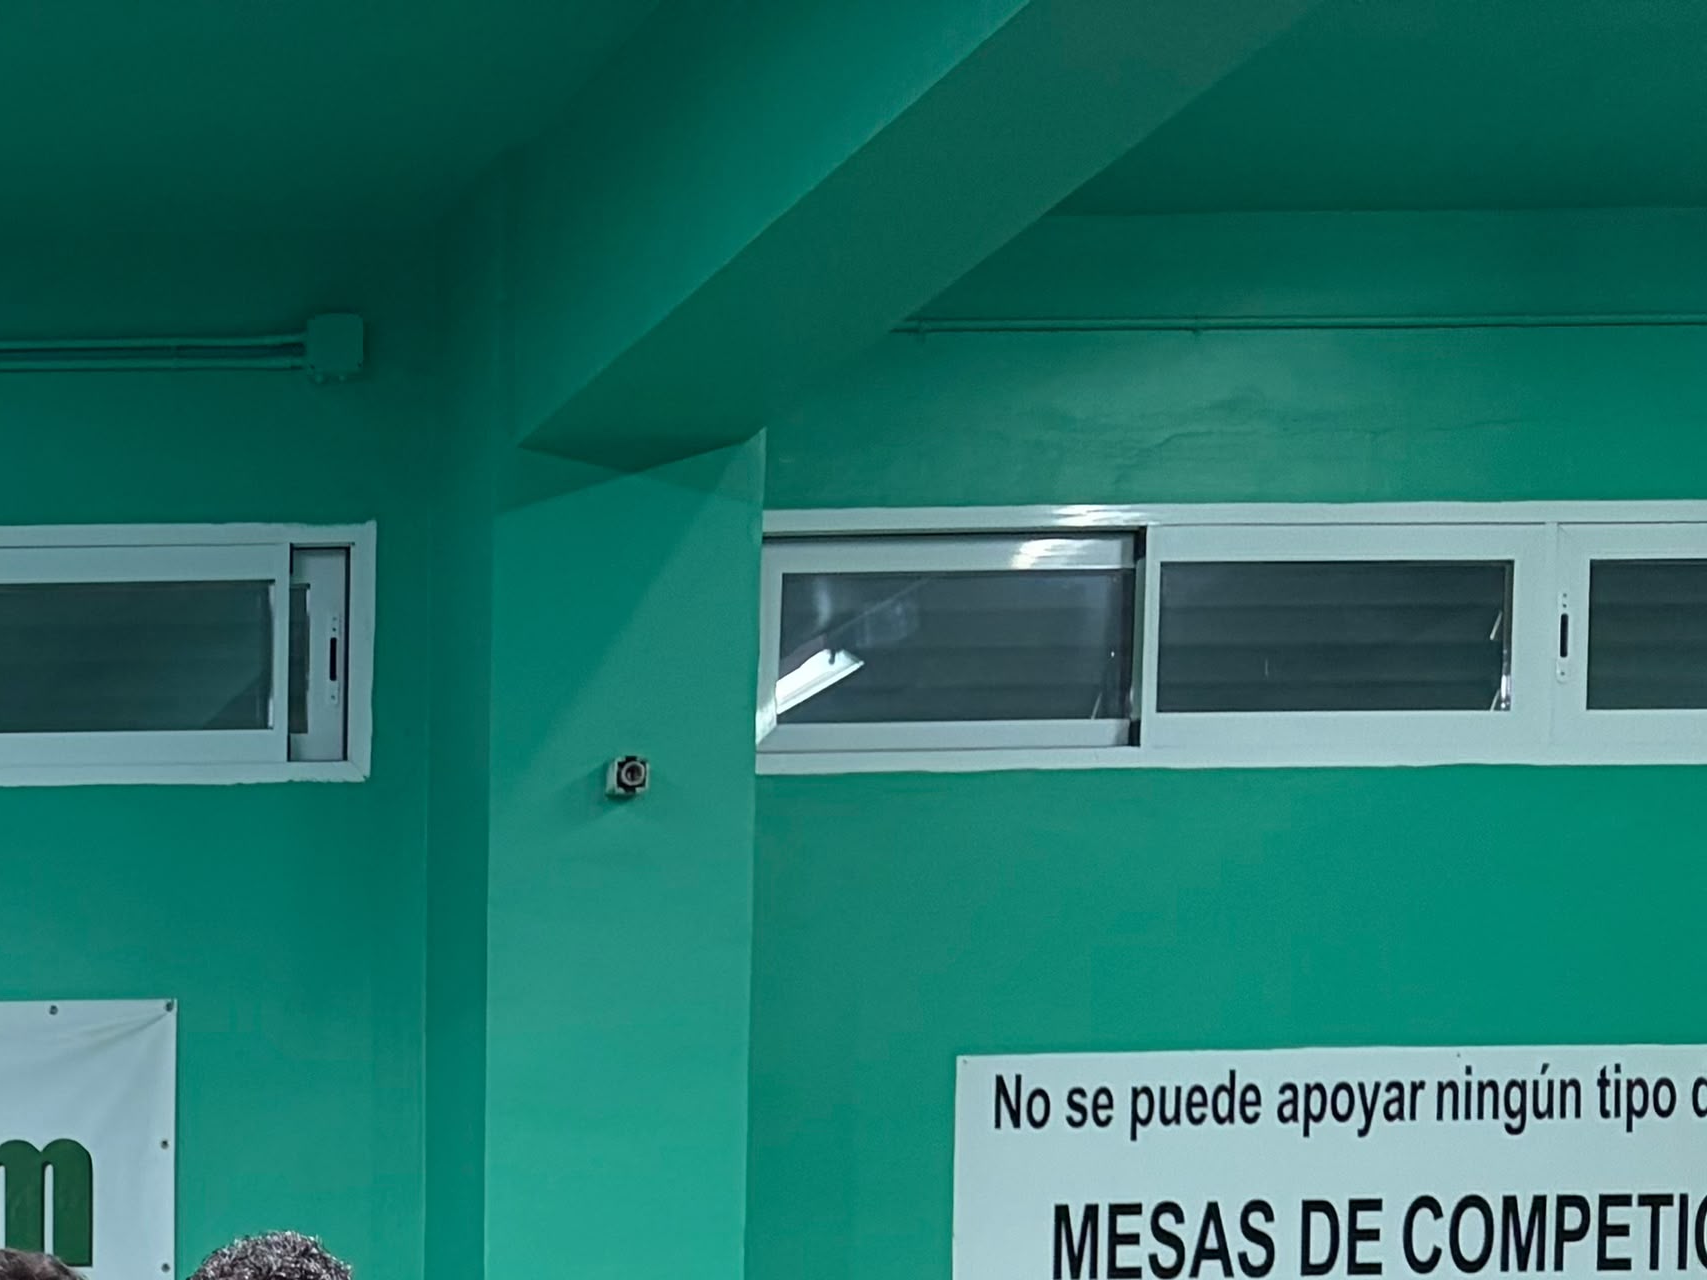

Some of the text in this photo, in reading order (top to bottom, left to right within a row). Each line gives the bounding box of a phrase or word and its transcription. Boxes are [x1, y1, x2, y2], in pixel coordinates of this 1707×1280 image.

[994, 1073, 1050, 1129] No
[1065, 1083, 1114, 1127] se
[1130, 1070, 1262, 1141] puede
[1277, 1077, 1426, 1138] apoyar
[1436, 1063, 1582, 1135] ningún
[1597, 1063, 1677, 1133] tipo
[1052, 1200, 1276, 1280] MESAS
[1300, 1198, 1384, 1276] DE
